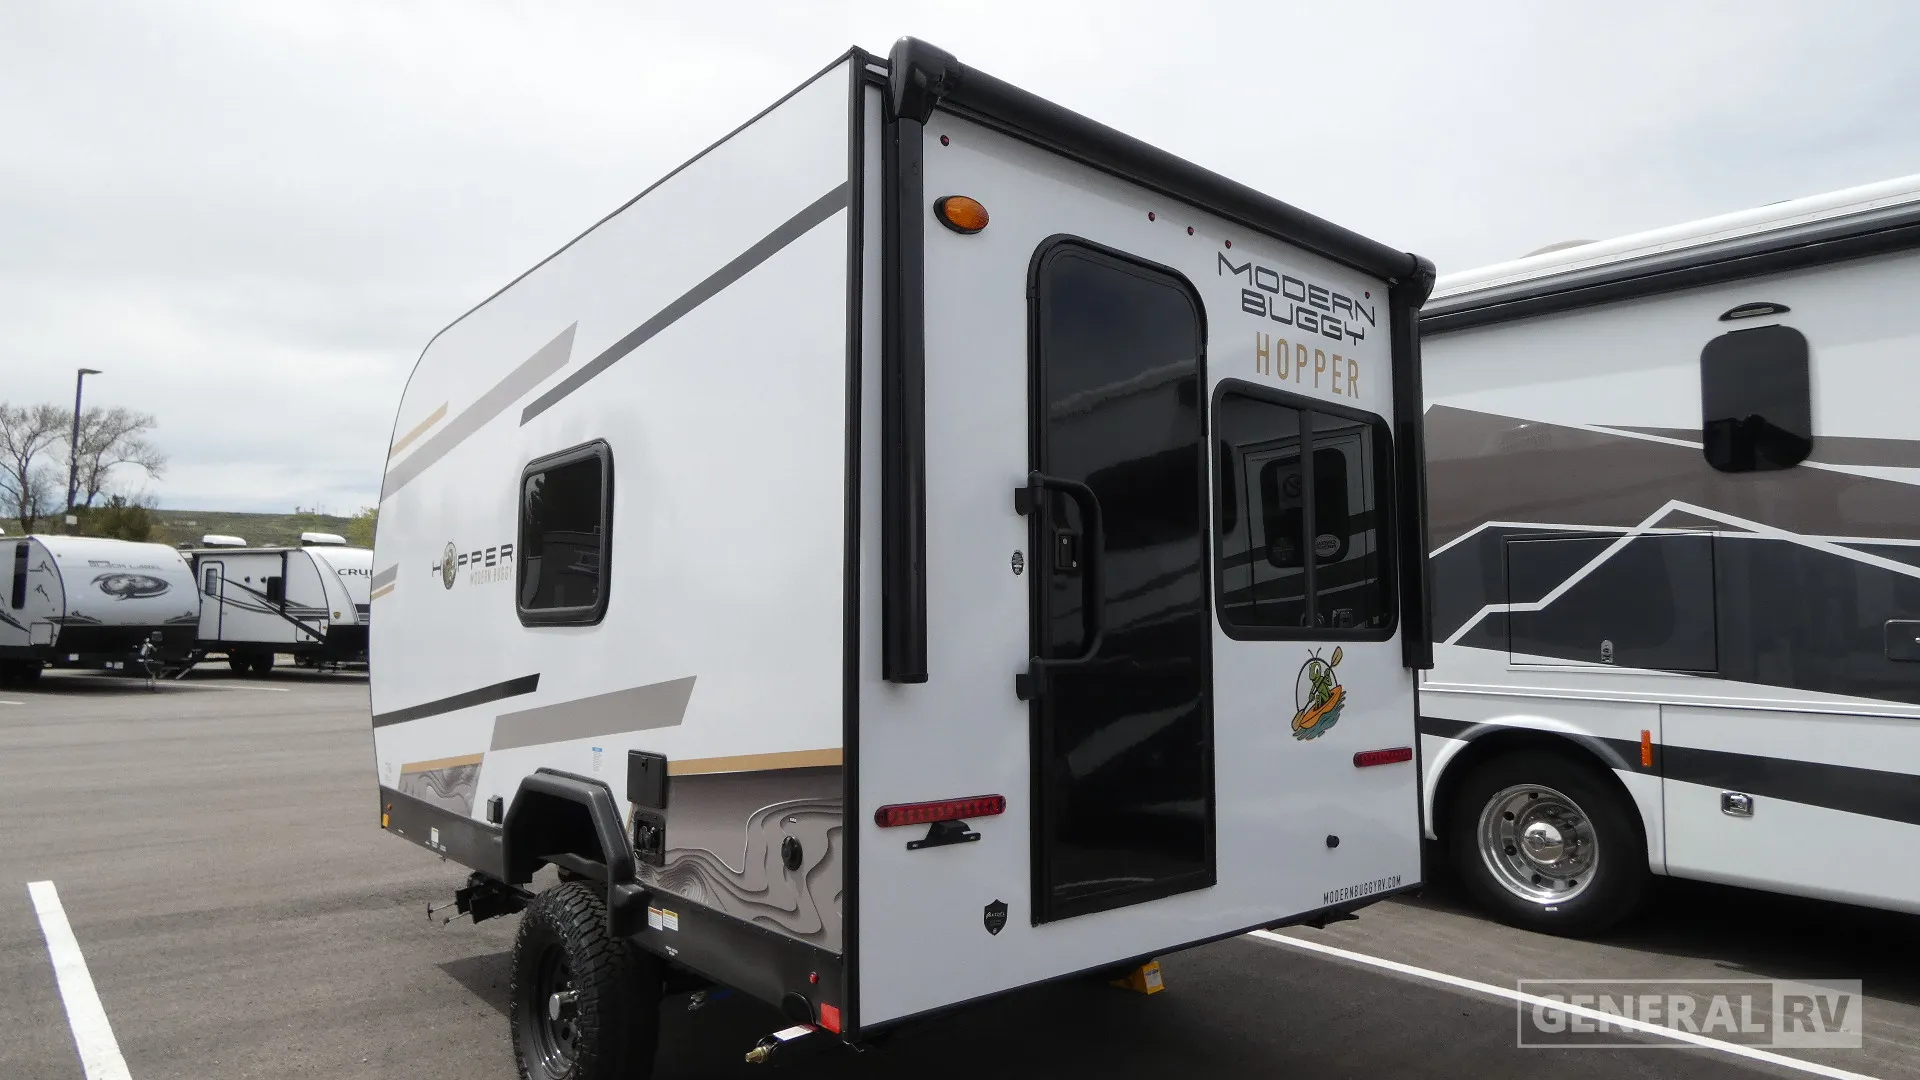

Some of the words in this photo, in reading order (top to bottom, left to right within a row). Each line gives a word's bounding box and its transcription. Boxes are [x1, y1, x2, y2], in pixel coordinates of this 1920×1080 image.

[1217, 251, 1376, 328] MODERN
[1241, 287, 1365, 347] BUGGY
[1256, 331, 1360, 400] HOPPER
[1323, 874, 1402, 905] MODERNBUGGYRV.COM
